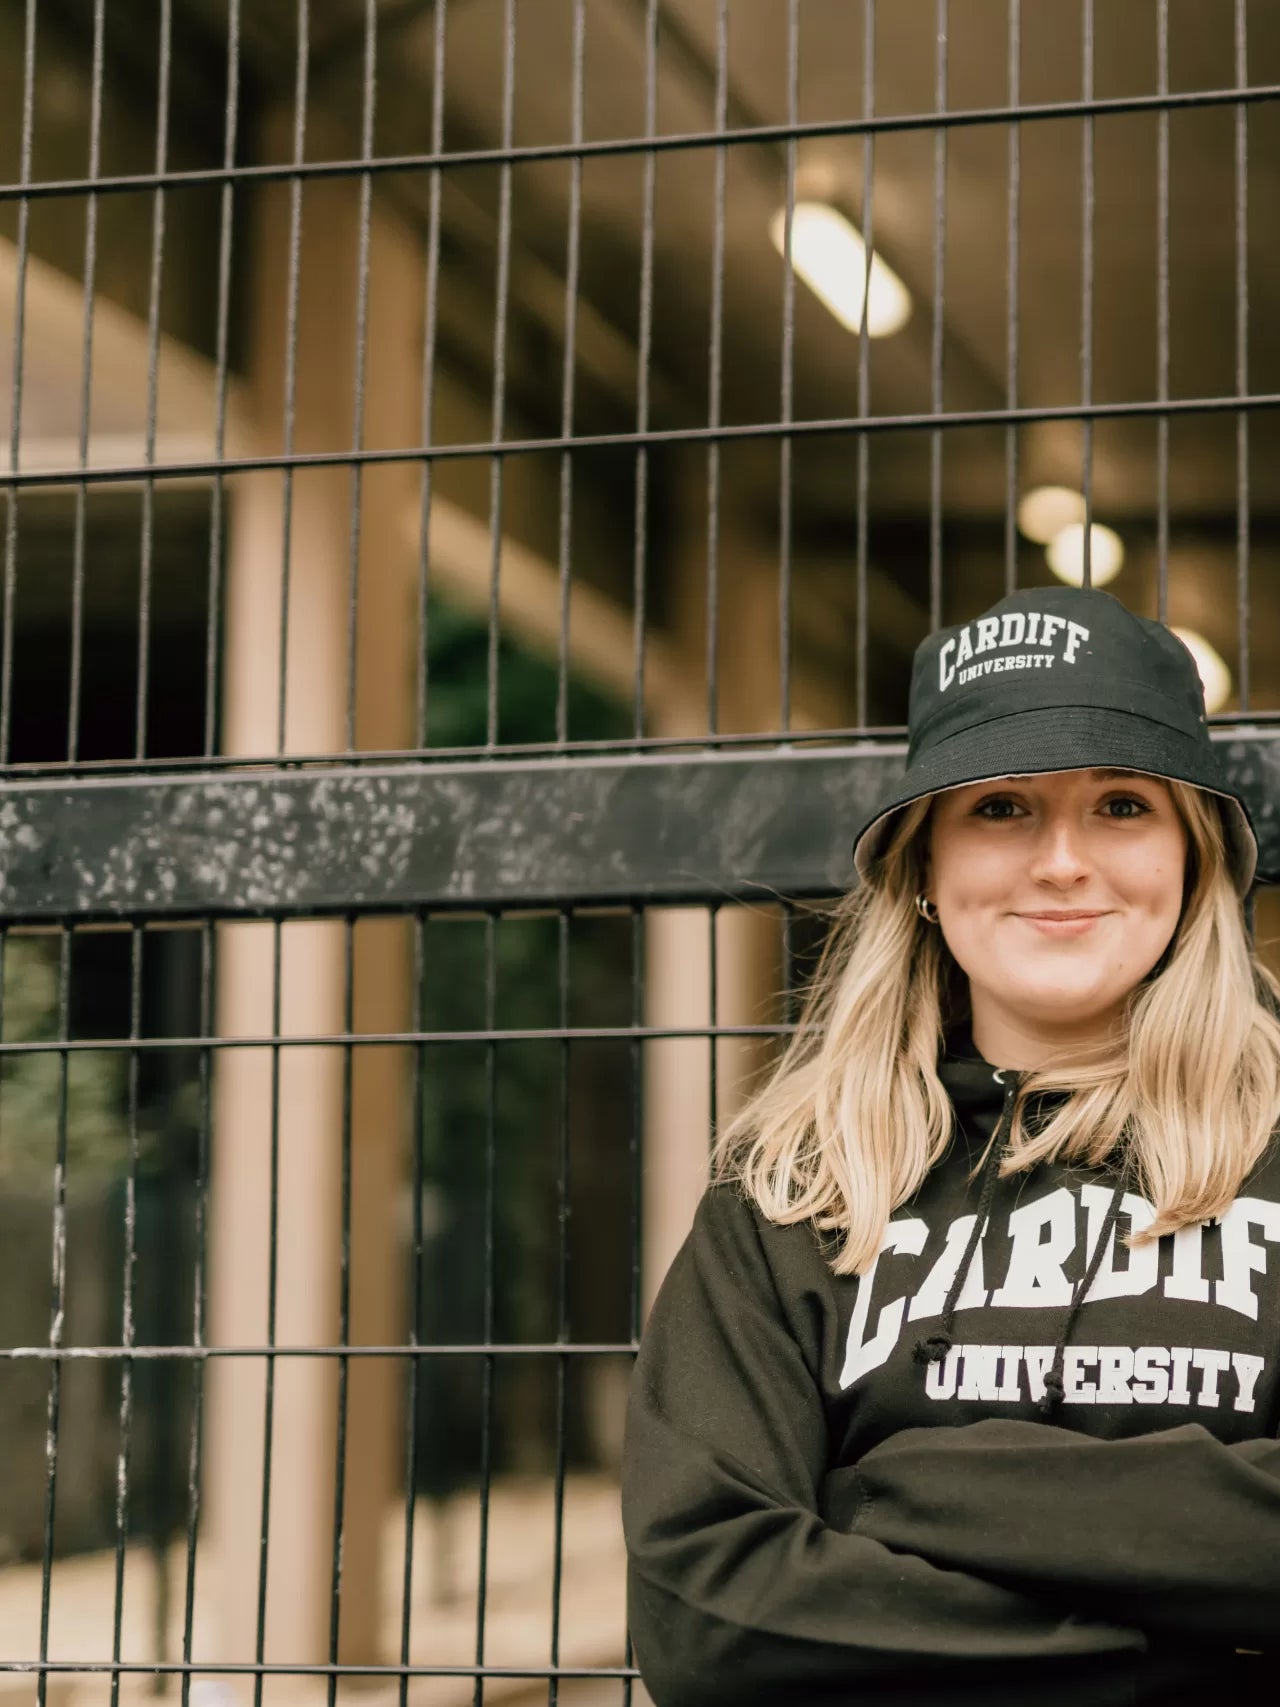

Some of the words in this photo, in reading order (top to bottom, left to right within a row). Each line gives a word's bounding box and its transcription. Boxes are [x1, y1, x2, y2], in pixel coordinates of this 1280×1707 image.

[939, 612, 1090, 692] CARDIFF
[958, 654, 1055, 685] UNIVERSITY
[925, 1344, 1265, 1413] UNIVERSITY
